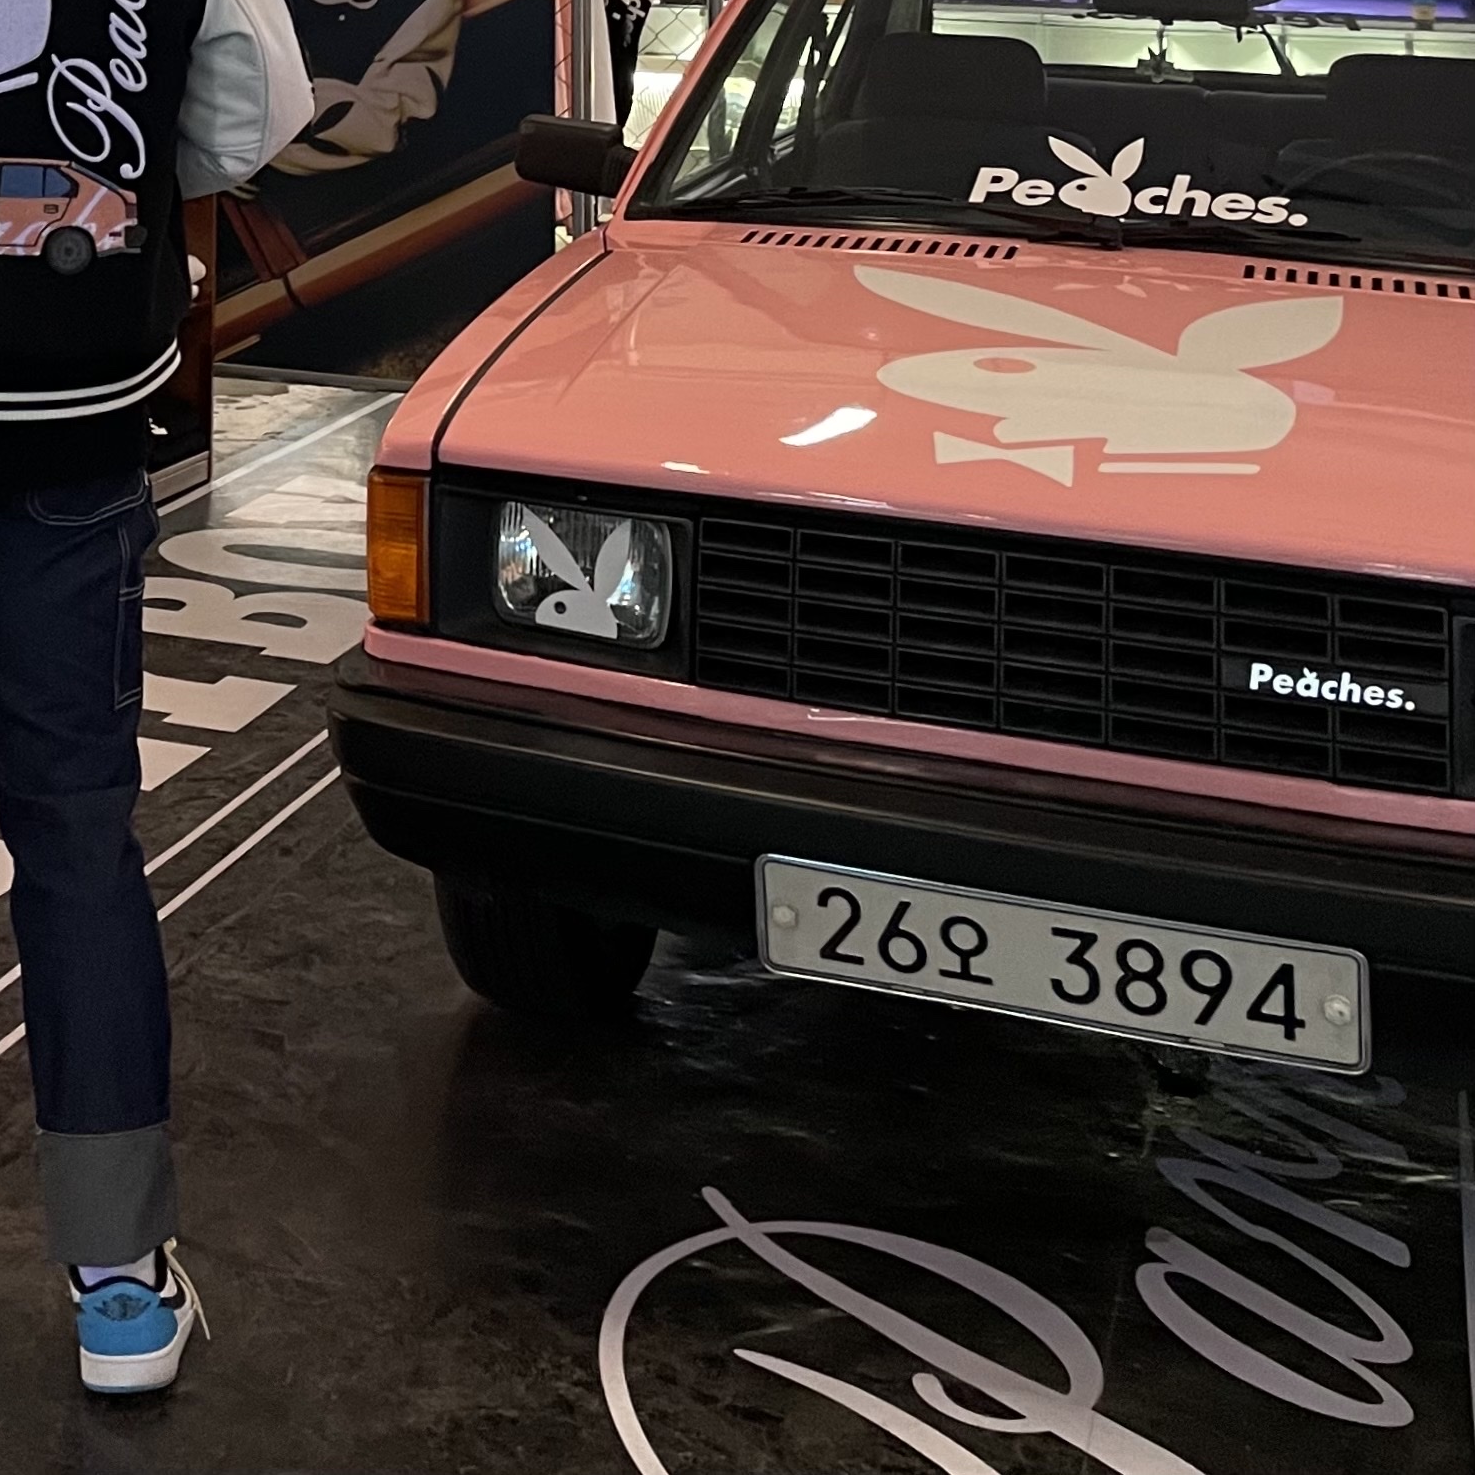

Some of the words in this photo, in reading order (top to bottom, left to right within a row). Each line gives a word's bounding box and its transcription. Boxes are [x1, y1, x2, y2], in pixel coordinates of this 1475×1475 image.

[1248, 661, 1417, 713] Peaches.
[815, 884, 994, 987] 26오
[1048, 925, 1308, 1043] 3894
